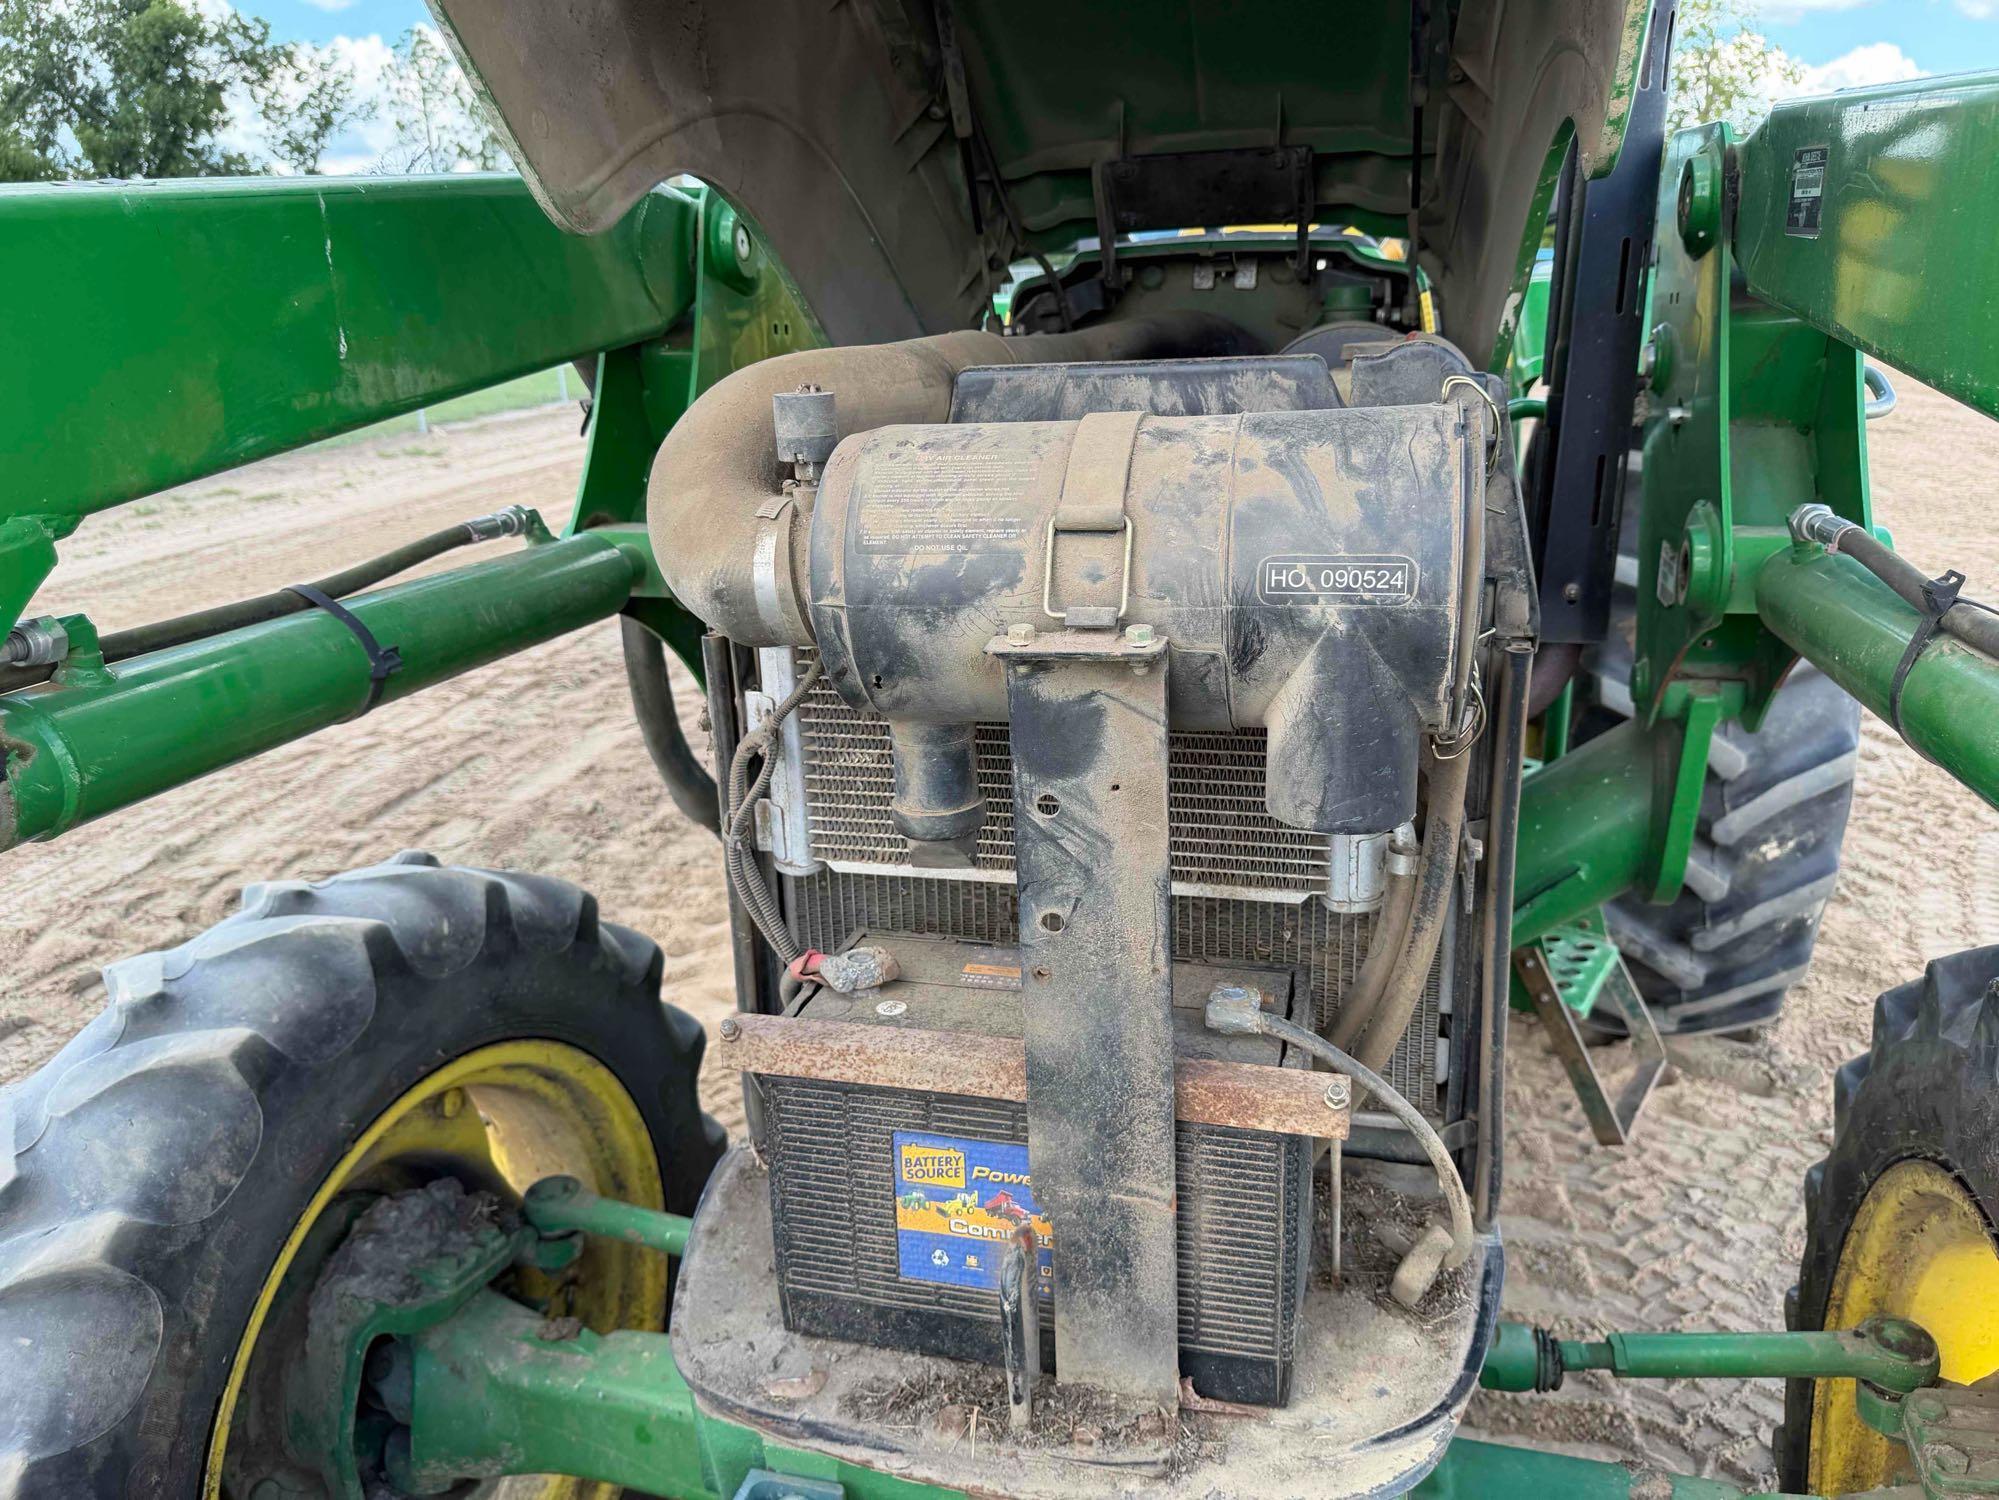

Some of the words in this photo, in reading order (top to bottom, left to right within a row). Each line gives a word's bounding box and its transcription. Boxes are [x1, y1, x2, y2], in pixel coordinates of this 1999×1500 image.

[1271, 569, 1306, 588] HO
[1320, 569, 1404, 589] 090524
[904, 1155, 962, 1169] BATTERY
[906, 1167, 961, 1180] SOURCE
